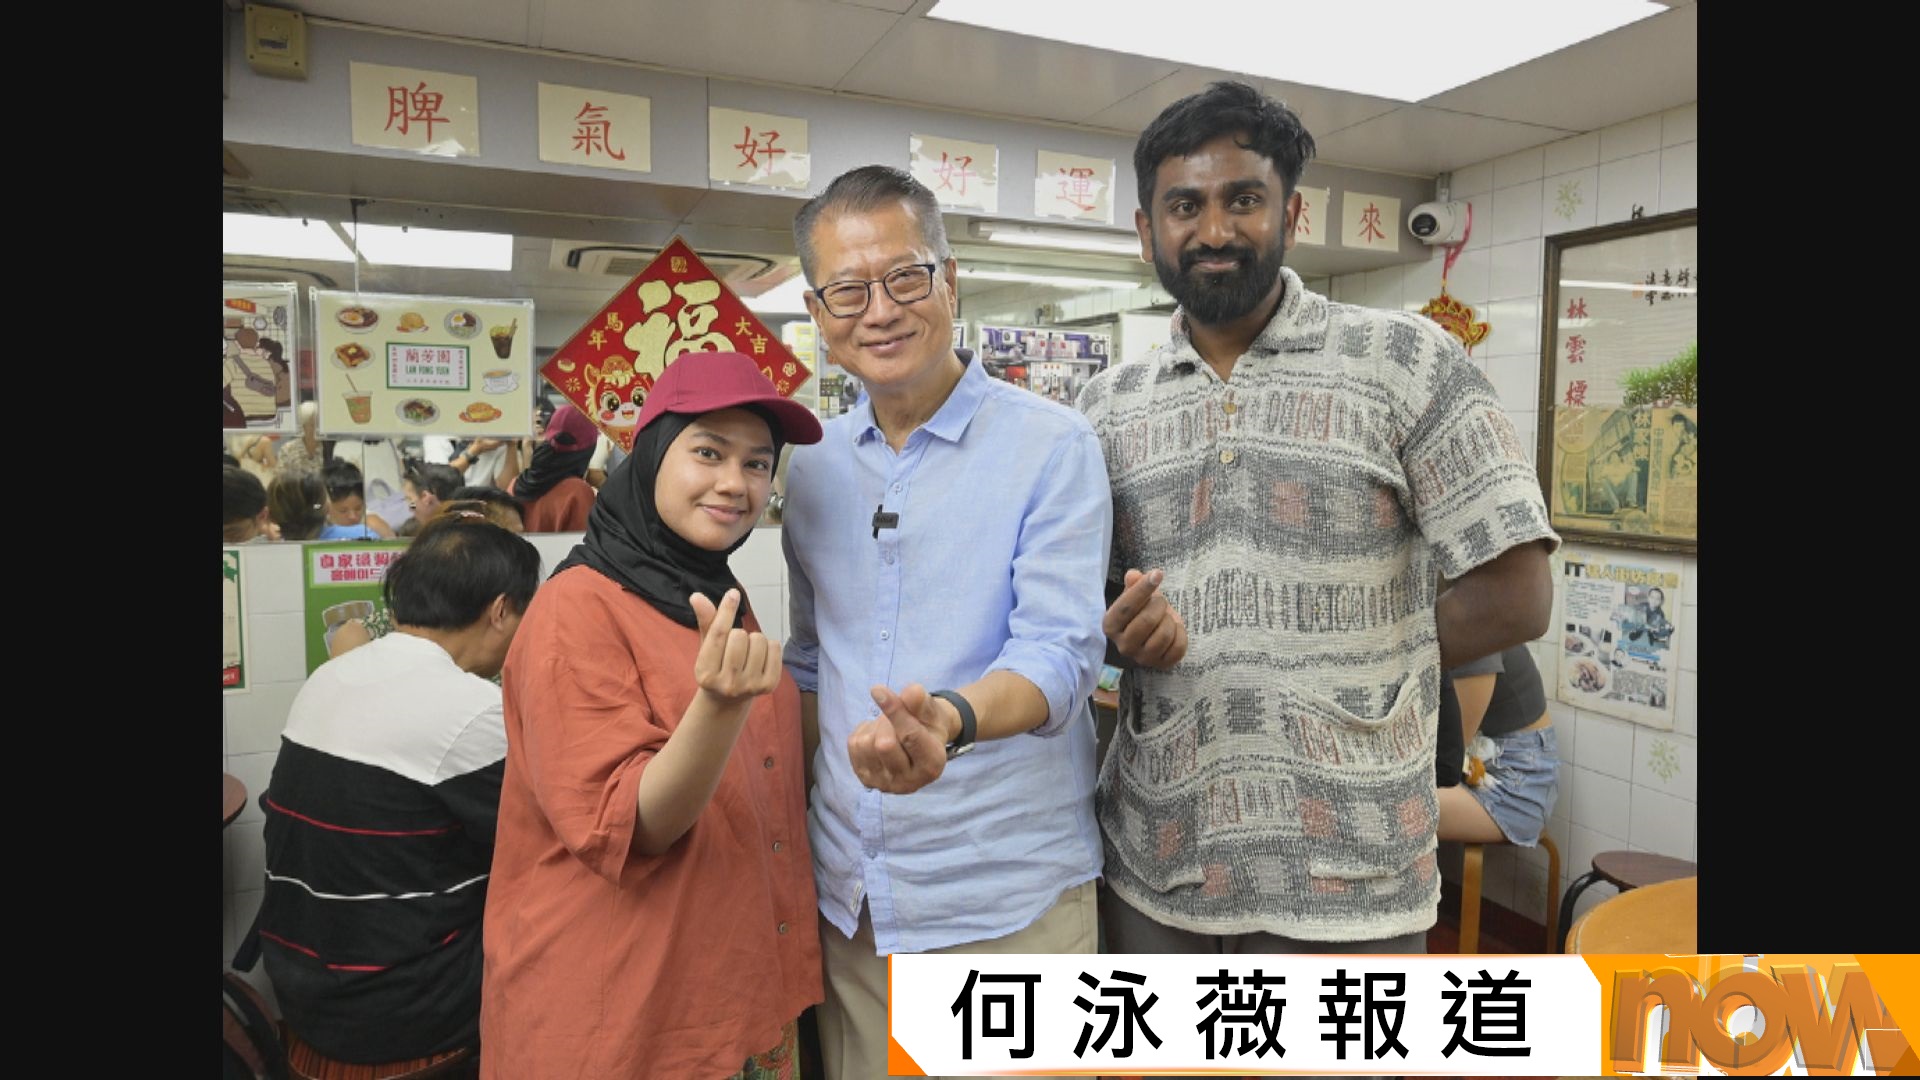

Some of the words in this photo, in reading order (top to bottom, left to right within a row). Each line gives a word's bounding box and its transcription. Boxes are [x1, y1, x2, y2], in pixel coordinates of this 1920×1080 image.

[587, 312, 624, 350] 馬年
[623, 279, 736, 382] 福
[735, 316, 768, 354] 大吉
